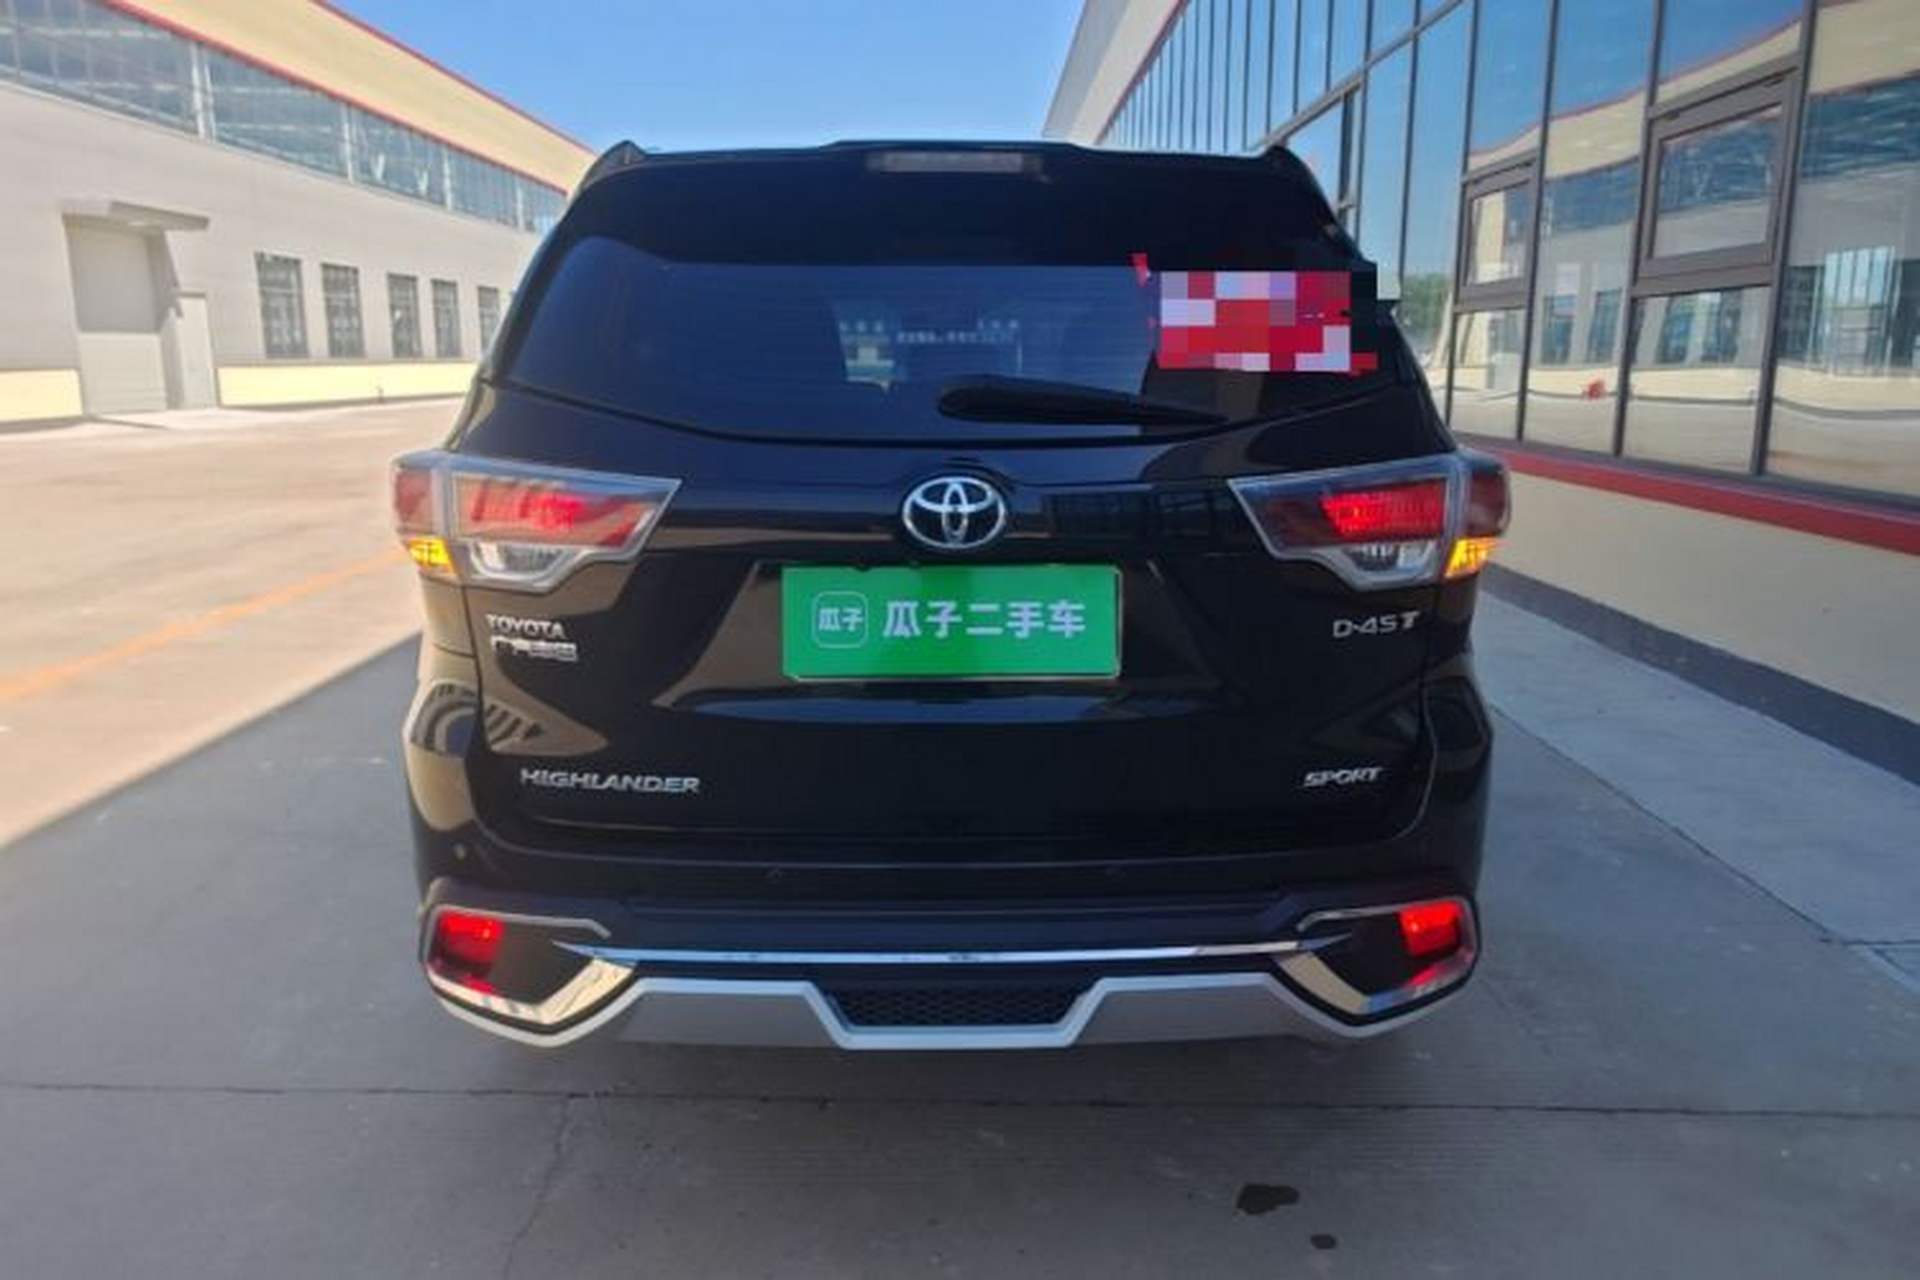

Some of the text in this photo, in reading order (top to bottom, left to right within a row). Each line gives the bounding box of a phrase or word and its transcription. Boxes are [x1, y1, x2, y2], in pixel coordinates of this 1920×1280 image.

[486, 614, 567, 640] TOYOTA
[817, 599, 1087, 639] 瓜子 瓜子二手车
[519, 767, 700, 794] HIGHLANDER
[1303, 766, 1384, 788] SPORT
